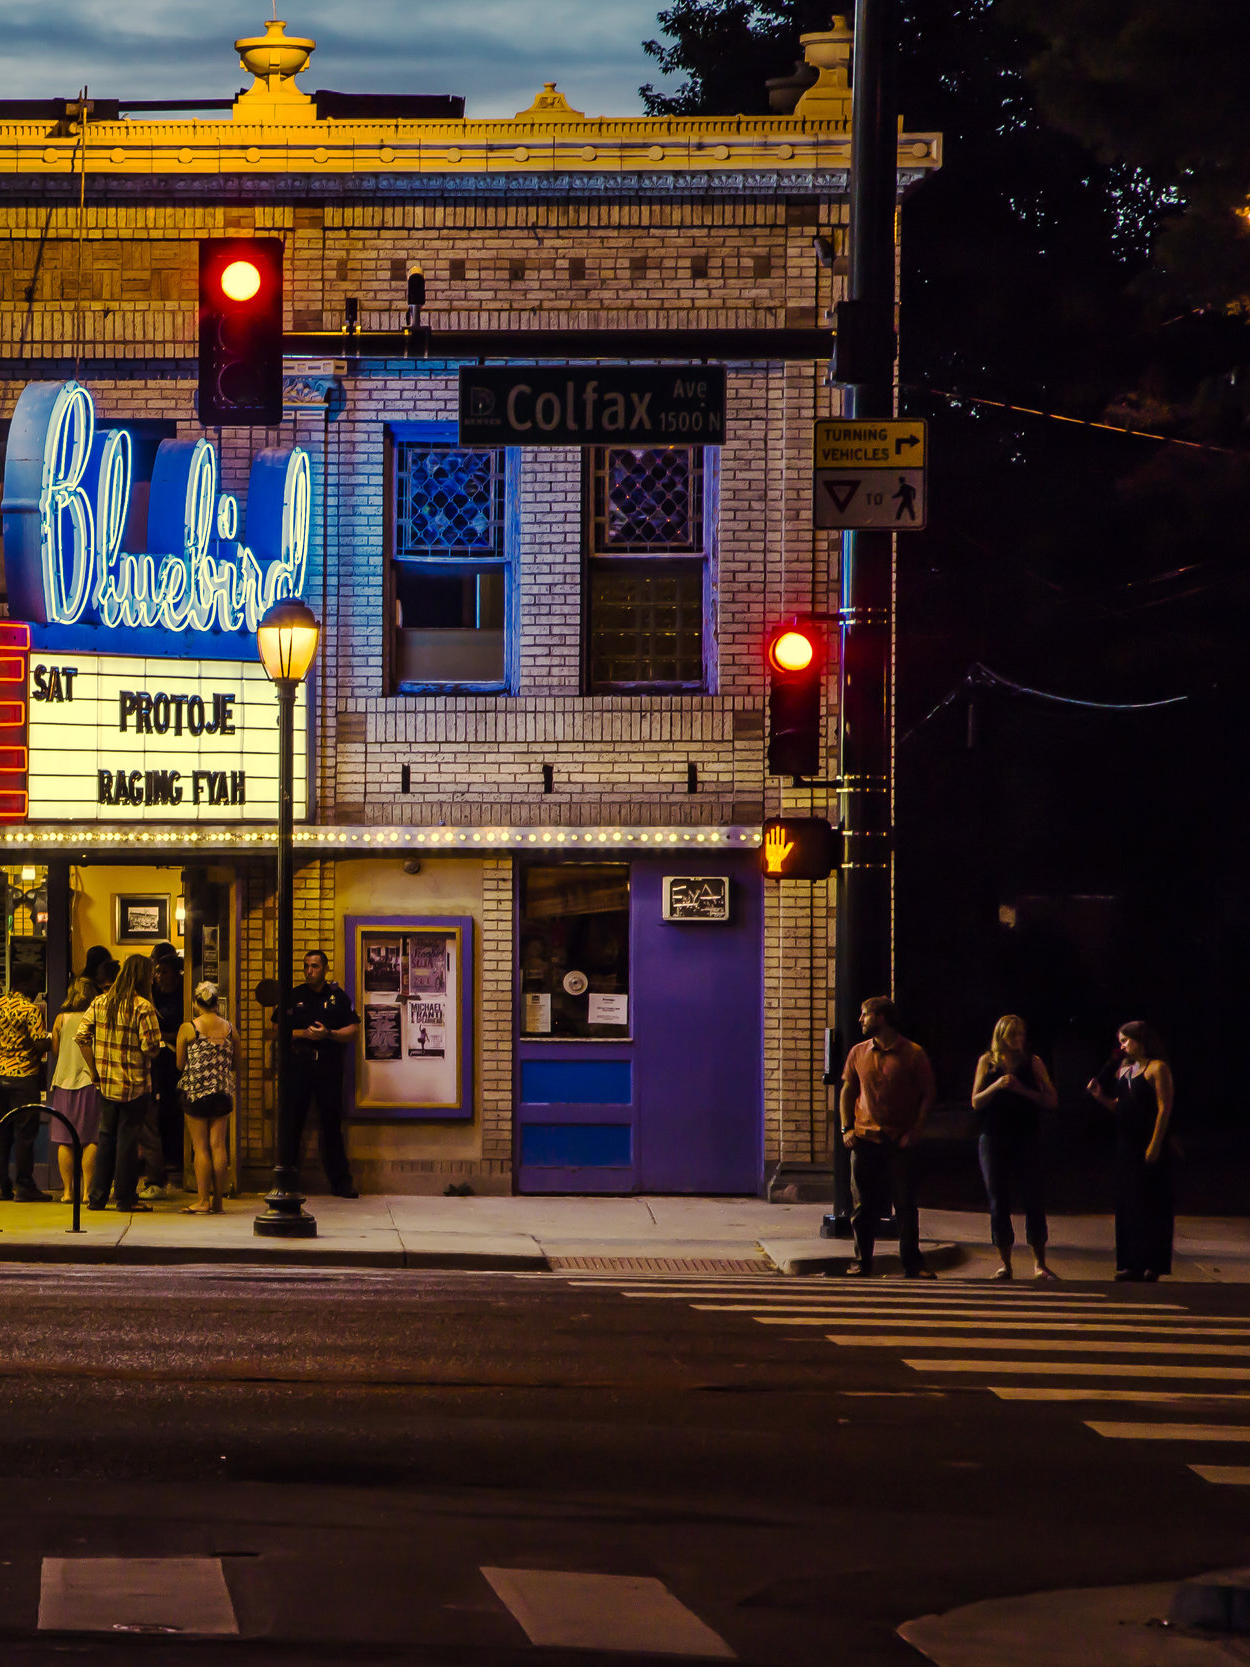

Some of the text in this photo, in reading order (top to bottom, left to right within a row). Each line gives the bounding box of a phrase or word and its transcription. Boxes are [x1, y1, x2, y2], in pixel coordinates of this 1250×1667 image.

[506, 378, 707, 431] Colfax Ave
[659, 411, 721, 432] 1500 N
[823, 428, 888, 442] TURNING
[821, 447, 890, 461] VEHICLES
[38, 379, 311, 633] Bluebird
[865, 492, 883, 506] TO
[32, 664, 78, 703] SAT
[119, 690, 236, 737] PROTOJE
[97, 769, 246, 806] RAGING FYAH
[410, 1003, 442, 1012] MICHAEL
